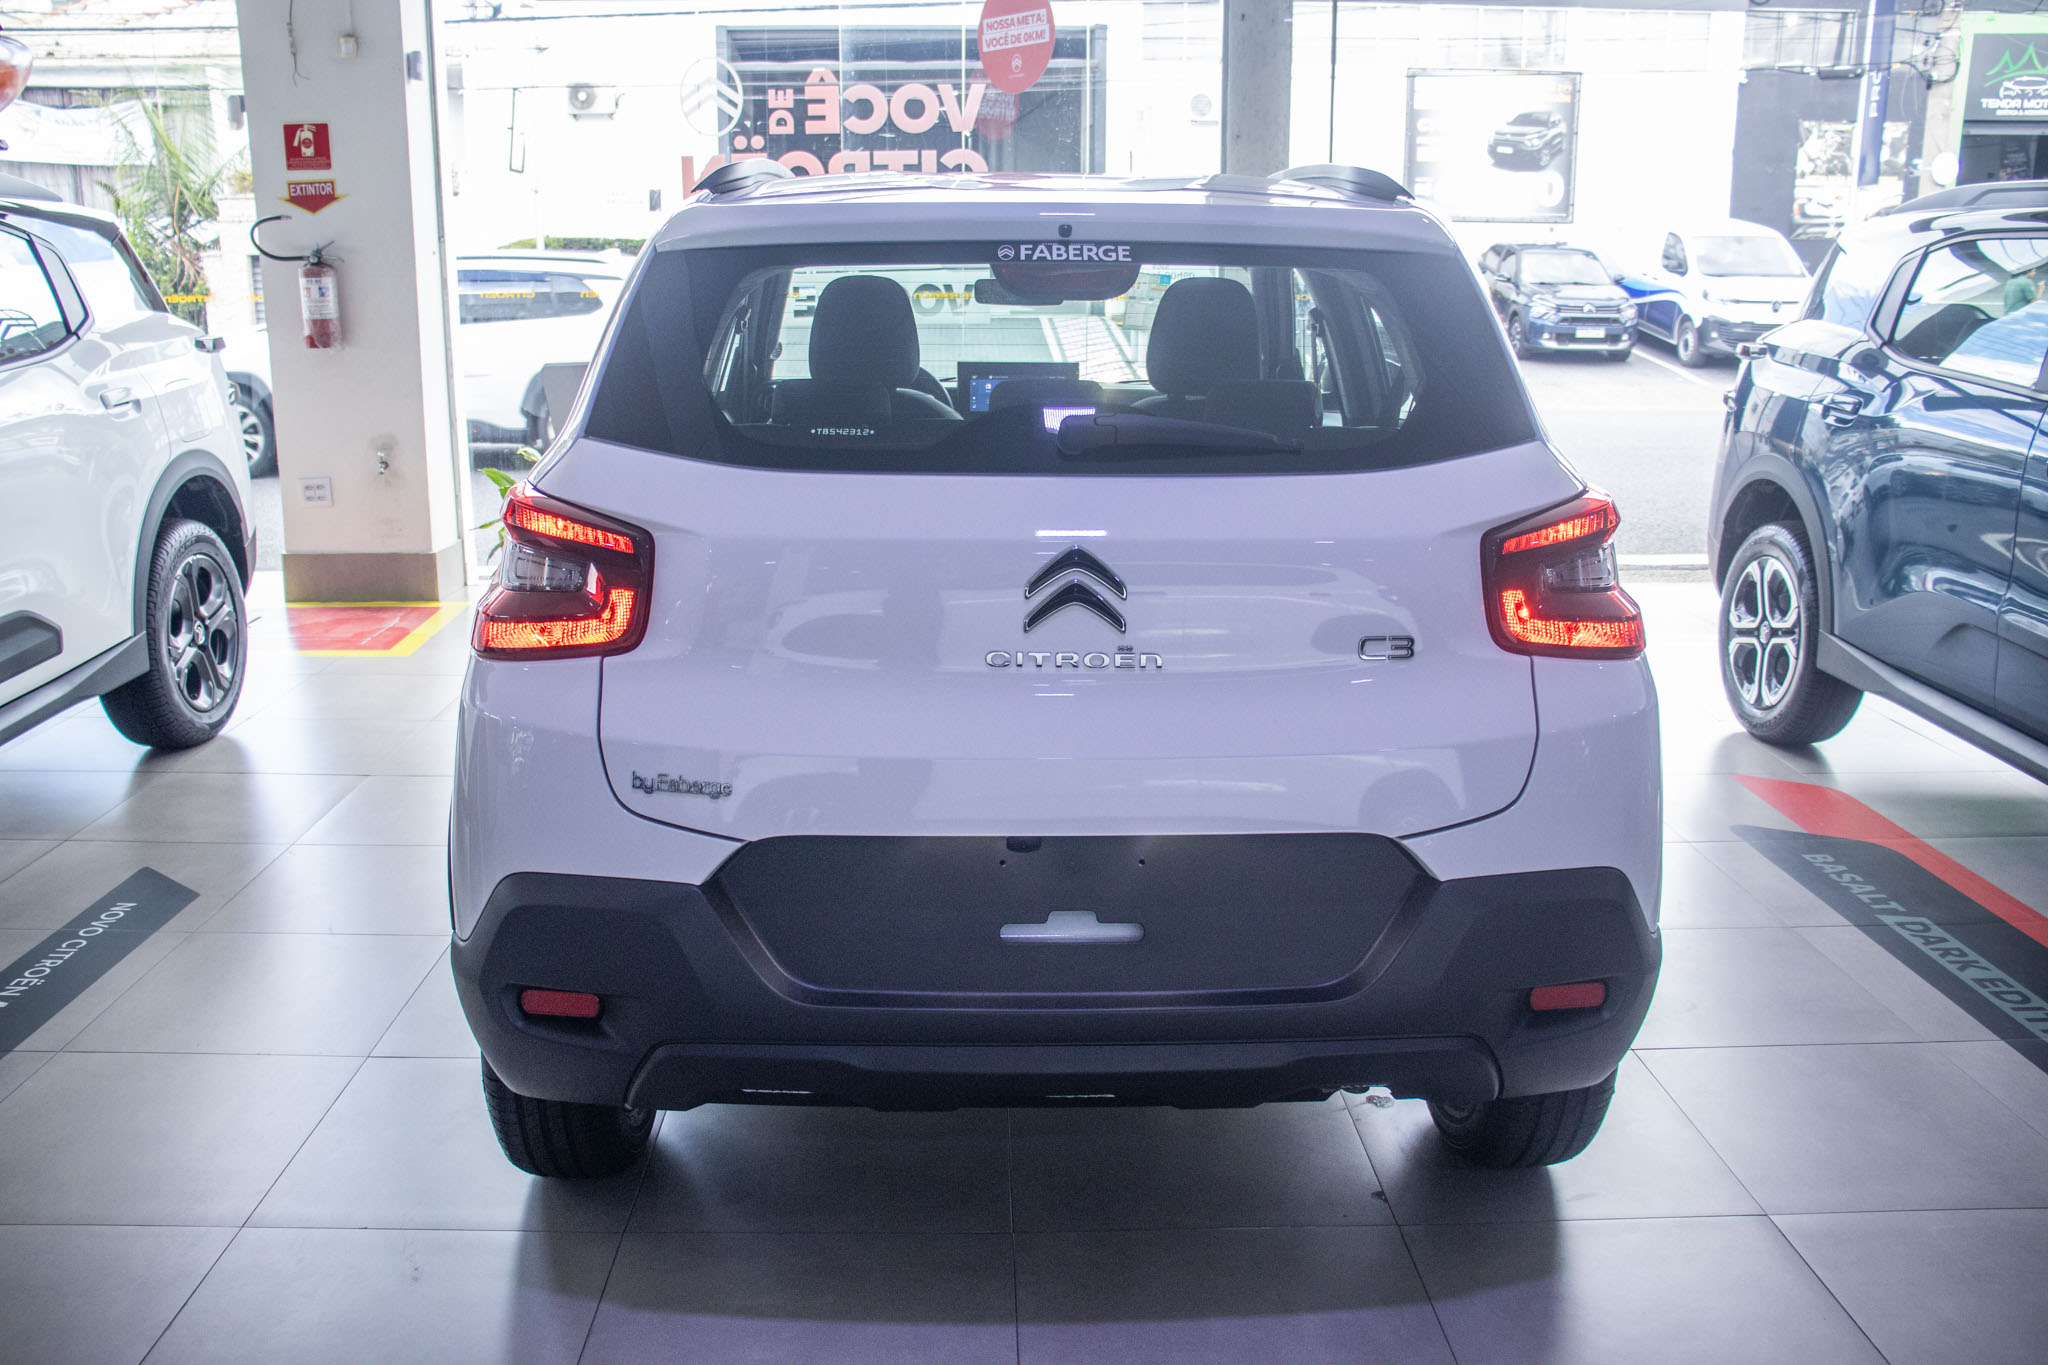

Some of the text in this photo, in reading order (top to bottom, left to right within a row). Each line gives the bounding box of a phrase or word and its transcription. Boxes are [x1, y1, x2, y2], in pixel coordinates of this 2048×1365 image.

[985, 11, 1046, 32] NOSSA META:
[985, 32, 1009, 48] VOCÊ
[1010, 33, 1022, 44] DE
[289, 183, 333, 197] EXTINTOR
[1020, 244, 1133, 262] FABERGE
[985, 645, 1162, 669] CITROËN
[1358, 635, 1415, 661] C3
[1801, 853, 1907, 912] BASALT
[1894, 921, 1992, 973] DARK
[0, 902, 138, 996] NOVO CITROËN
